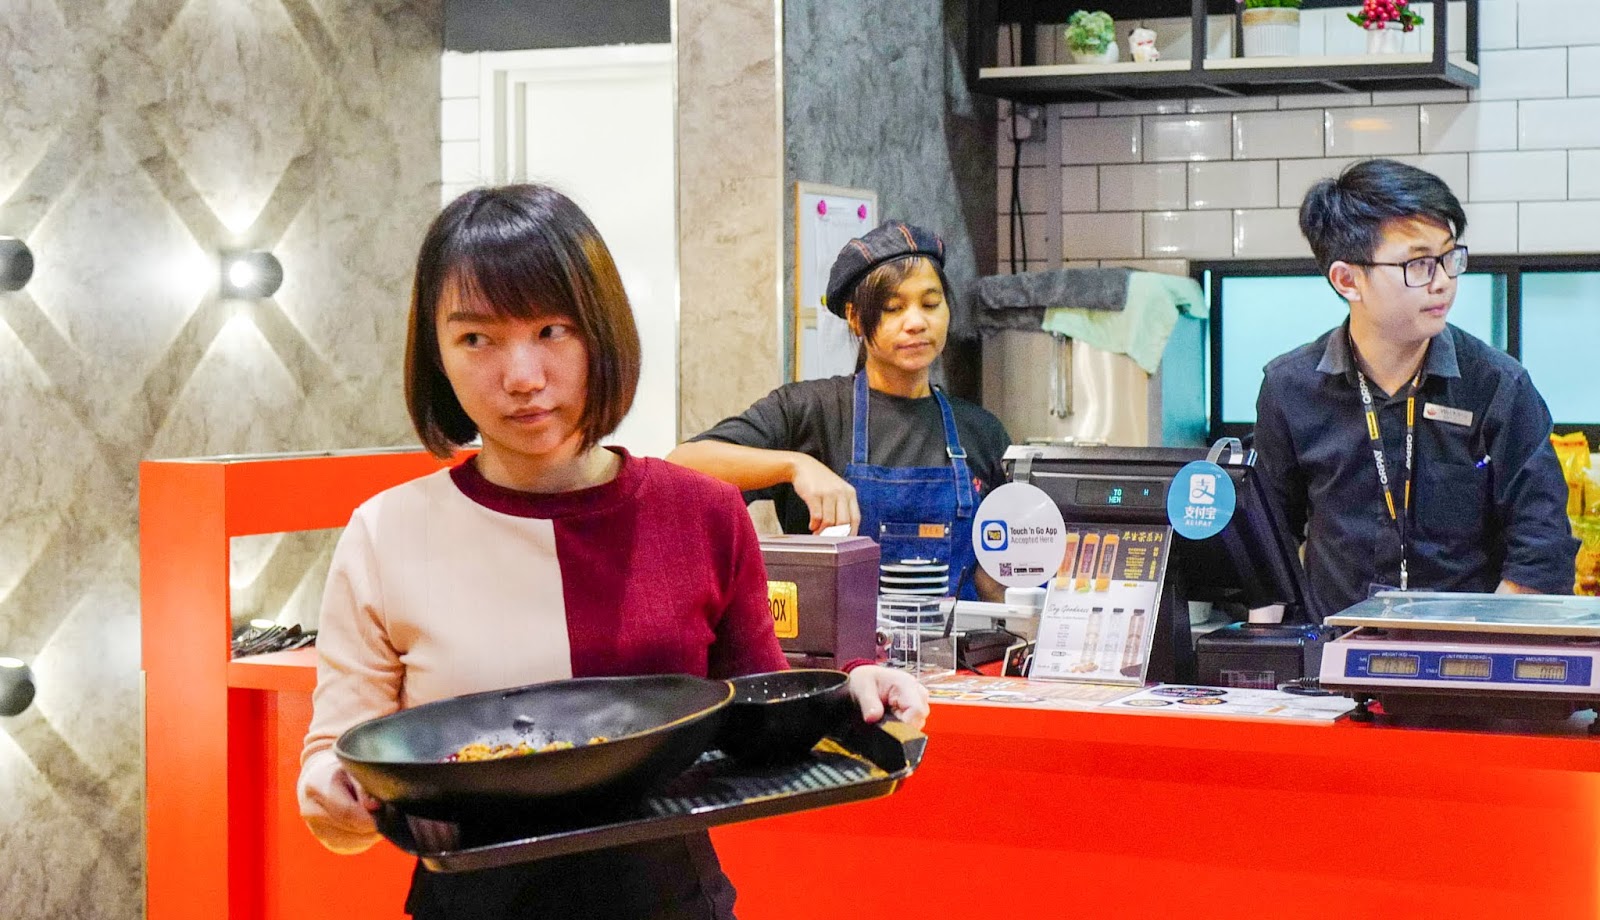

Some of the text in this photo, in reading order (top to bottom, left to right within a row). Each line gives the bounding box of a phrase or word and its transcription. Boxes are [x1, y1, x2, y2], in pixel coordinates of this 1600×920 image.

[1357, 371, 1371, 405] QRPAY
[1405, 434, 1413, 470] QRPAY
[1373, 449, 1388, 485] QRPAY
[1184, 506, 1217, 520] 支付宝
[1185, 519, 1212, 527] ALIPAY
[1010, 527, 1028, 535] Touch
[1028, 527, 1035, 535] 'n
[1036, 526, 1045, 535] Go
[1046, 527, 1058, 536] App
[1010, 536, 1054, 544] Accepted Here
